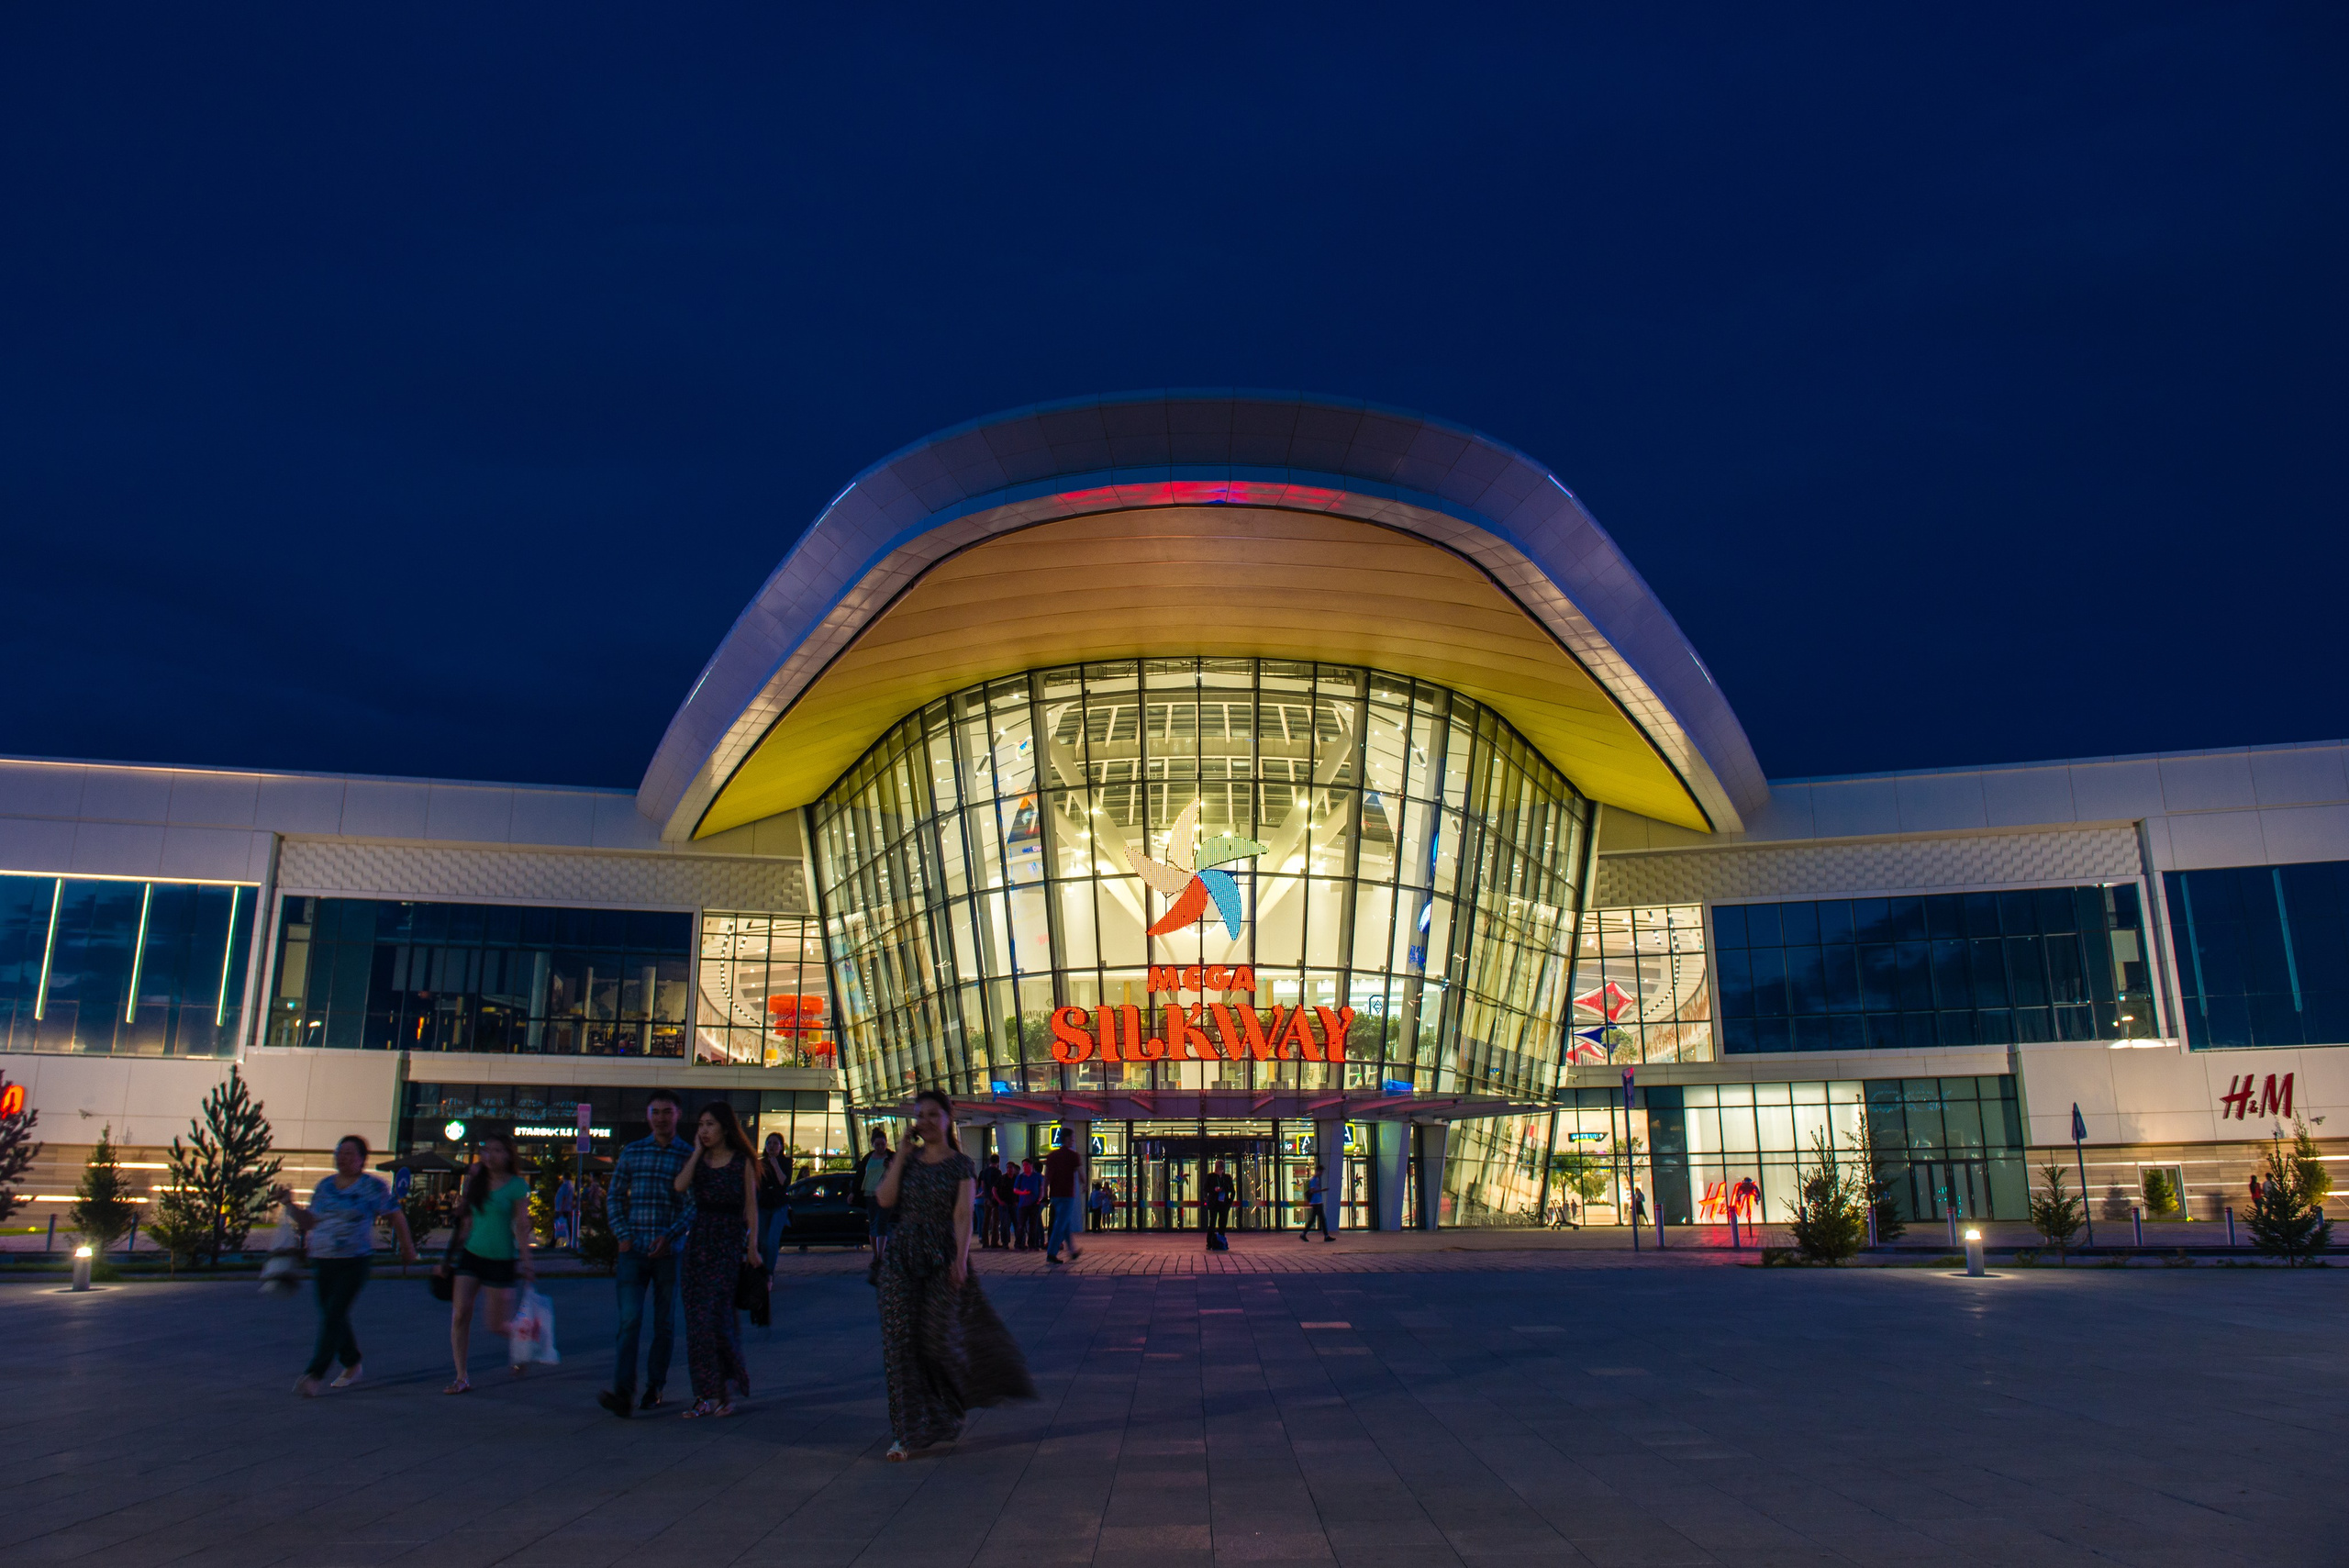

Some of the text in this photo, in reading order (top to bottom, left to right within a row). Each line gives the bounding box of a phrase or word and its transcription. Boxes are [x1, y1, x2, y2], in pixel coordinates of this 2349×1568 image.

[1146, 965, 1257, 993] MEGA
[1051, 1002, 1355, 1064] SILKWAY
[2220, 1073, 2294, 1120] H&M
[514, 1127, 611, 1138] STARBUCKS CFFEE
